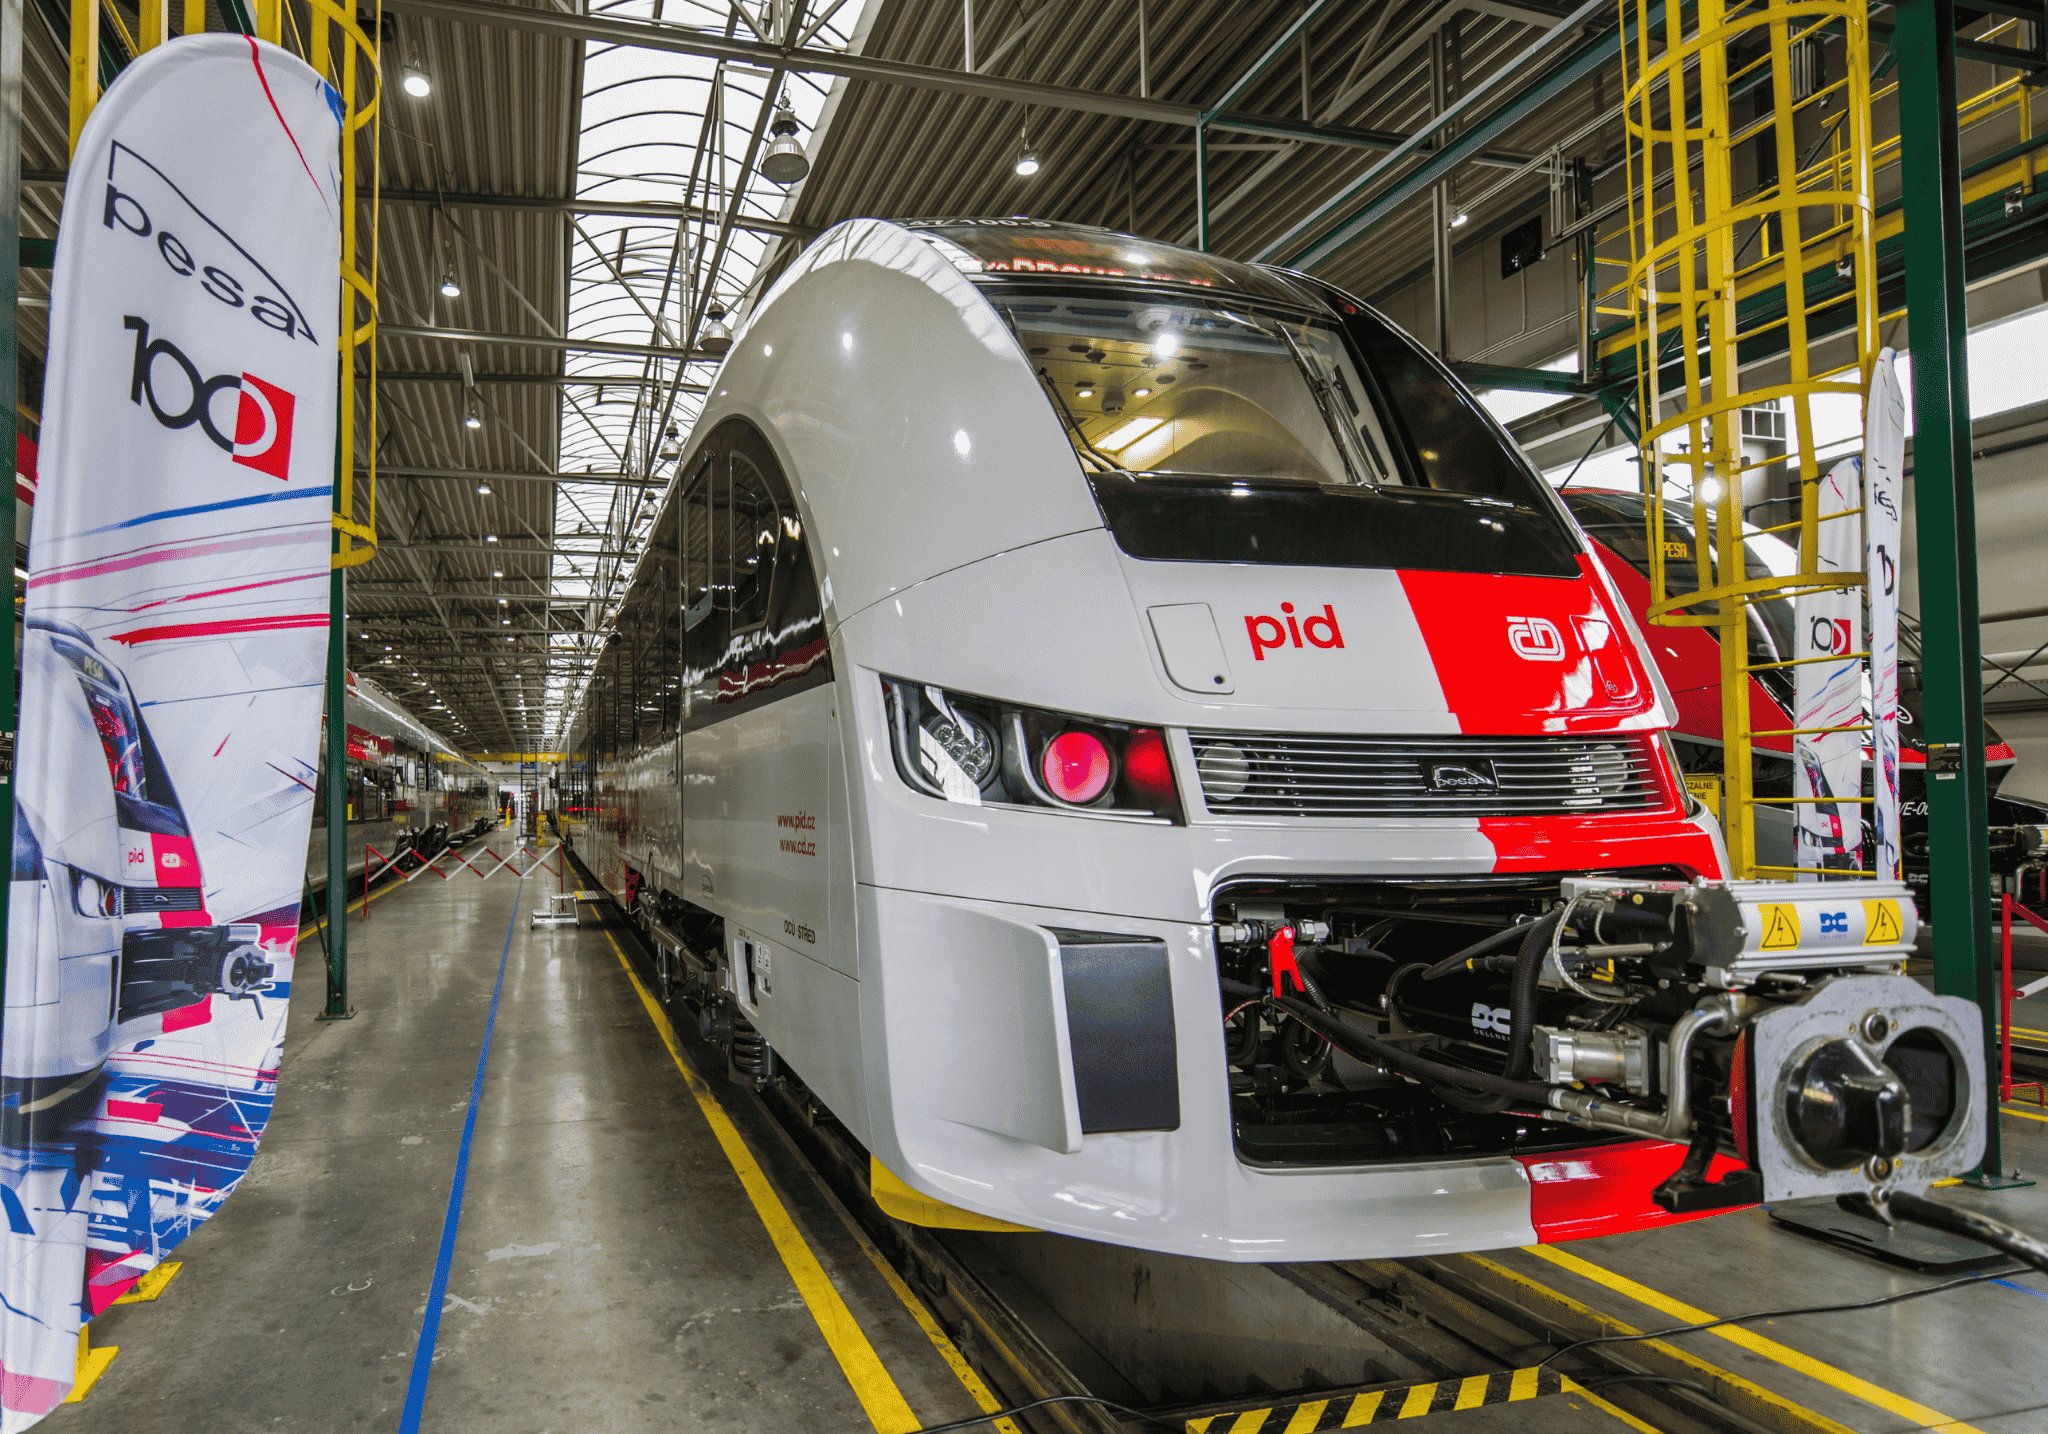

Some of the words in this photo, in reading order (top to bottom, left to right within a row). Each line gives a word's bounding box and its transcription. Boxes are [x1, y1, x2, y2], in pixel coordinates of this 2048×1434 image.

[102, 183, 299, 341] pesa
[123, 315, 279, 458] 100
[1243, 601, 1346, 661] pid
[777, 811, 815, 832] www.pid.cz
[128, 848, 145, 866] pid
[780, 837, 815, 856] www.cd.cz
[798, 924, 816, 944] STŘED
